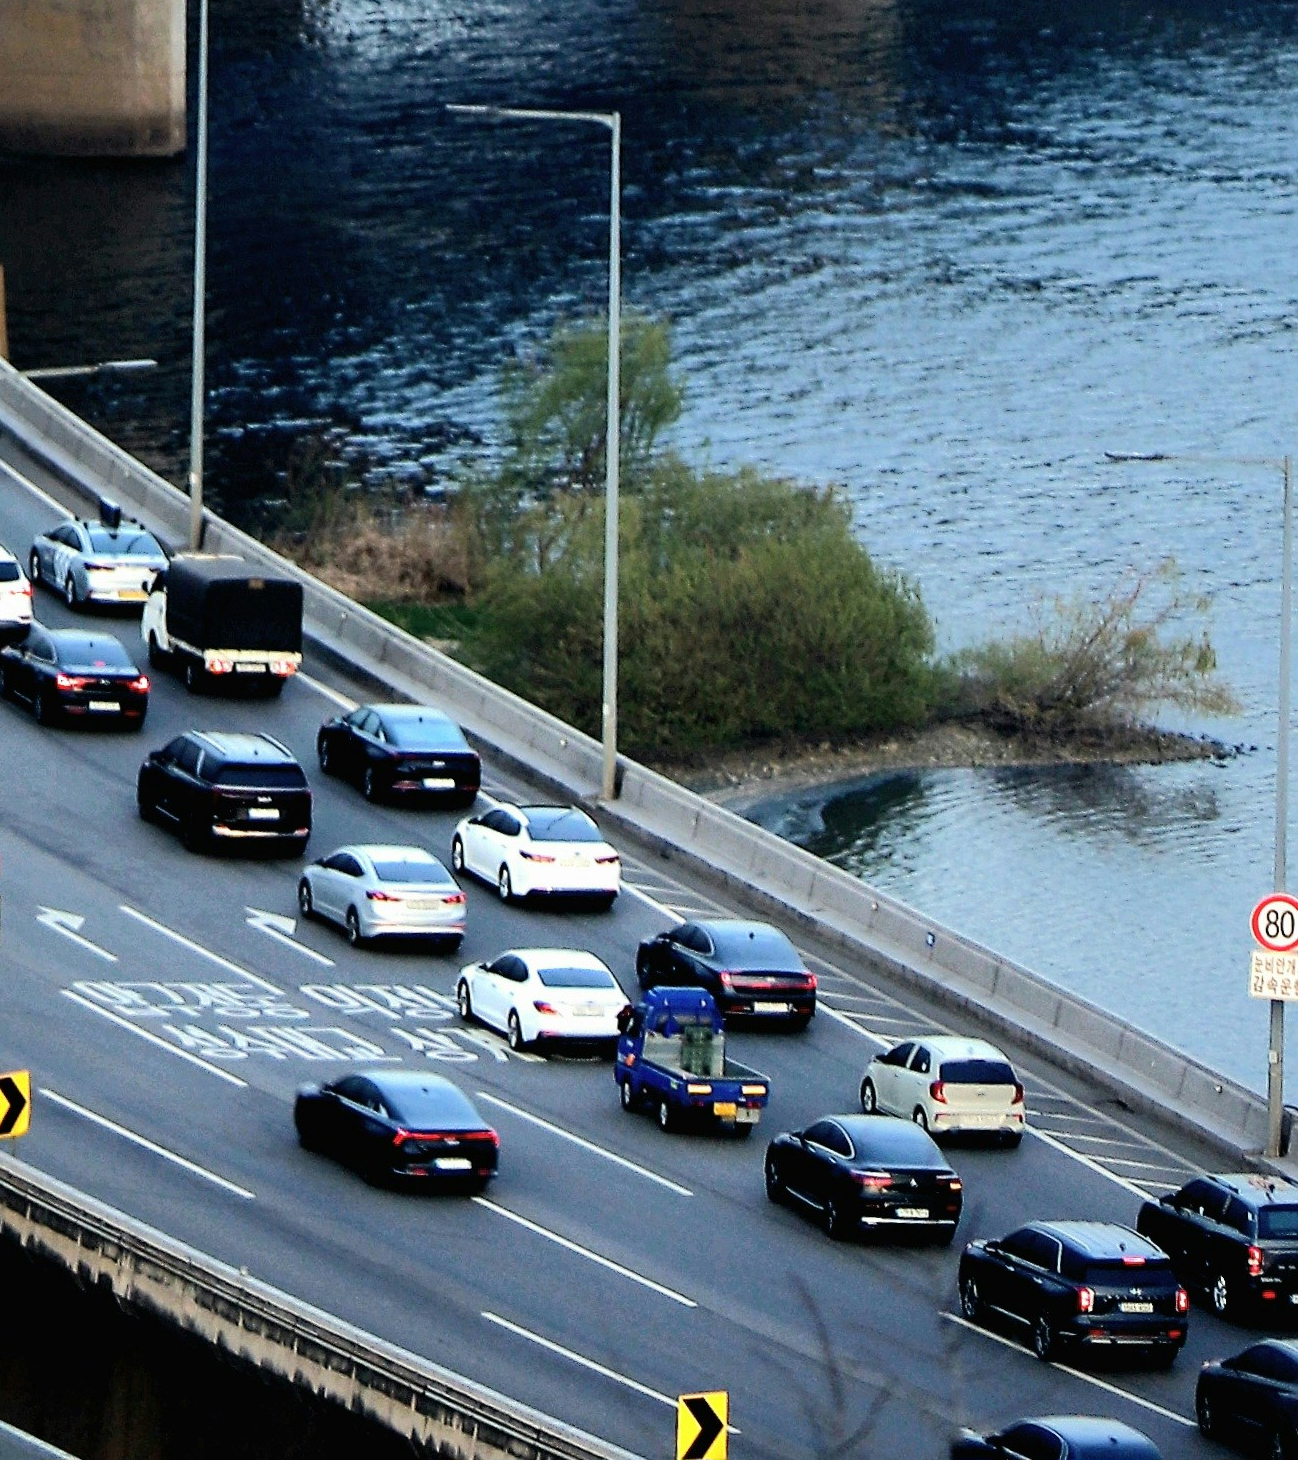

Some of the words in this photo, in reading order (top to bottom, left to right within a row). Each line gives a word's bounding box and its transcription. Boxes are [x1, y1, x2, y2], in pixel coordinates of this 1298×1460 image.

[1265, 908, 1295, 939] 80
[1254, 955, 1298, 976] 눈비안개
[162, 1023, 403, 1062] 성수대교
